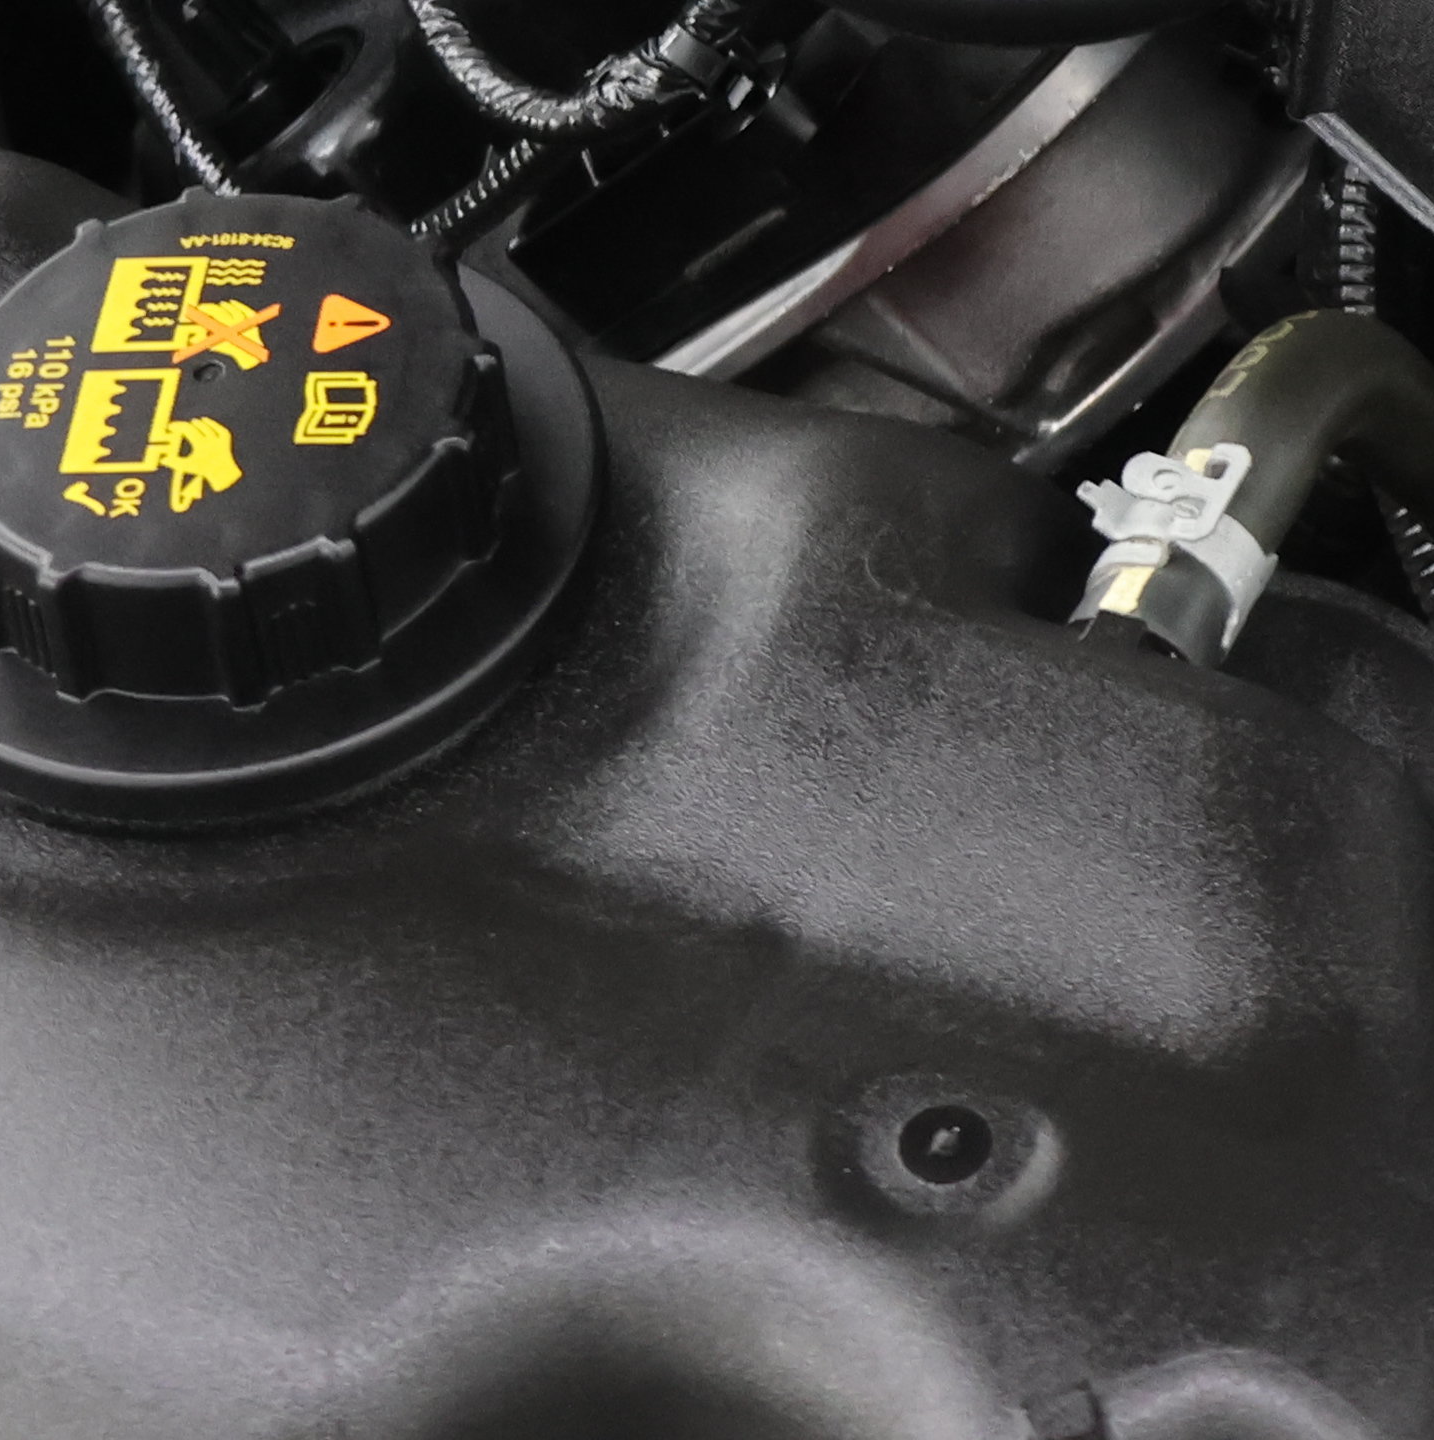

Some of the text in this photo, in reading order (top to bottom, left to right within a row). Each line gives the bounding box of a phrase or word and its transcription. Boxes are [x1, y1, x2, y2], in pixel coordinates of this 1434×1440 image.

[6, 348, 37, 380] 16
[22, 335, 75, 430] 110 kPa
[108, 477, 145, 519] OK
